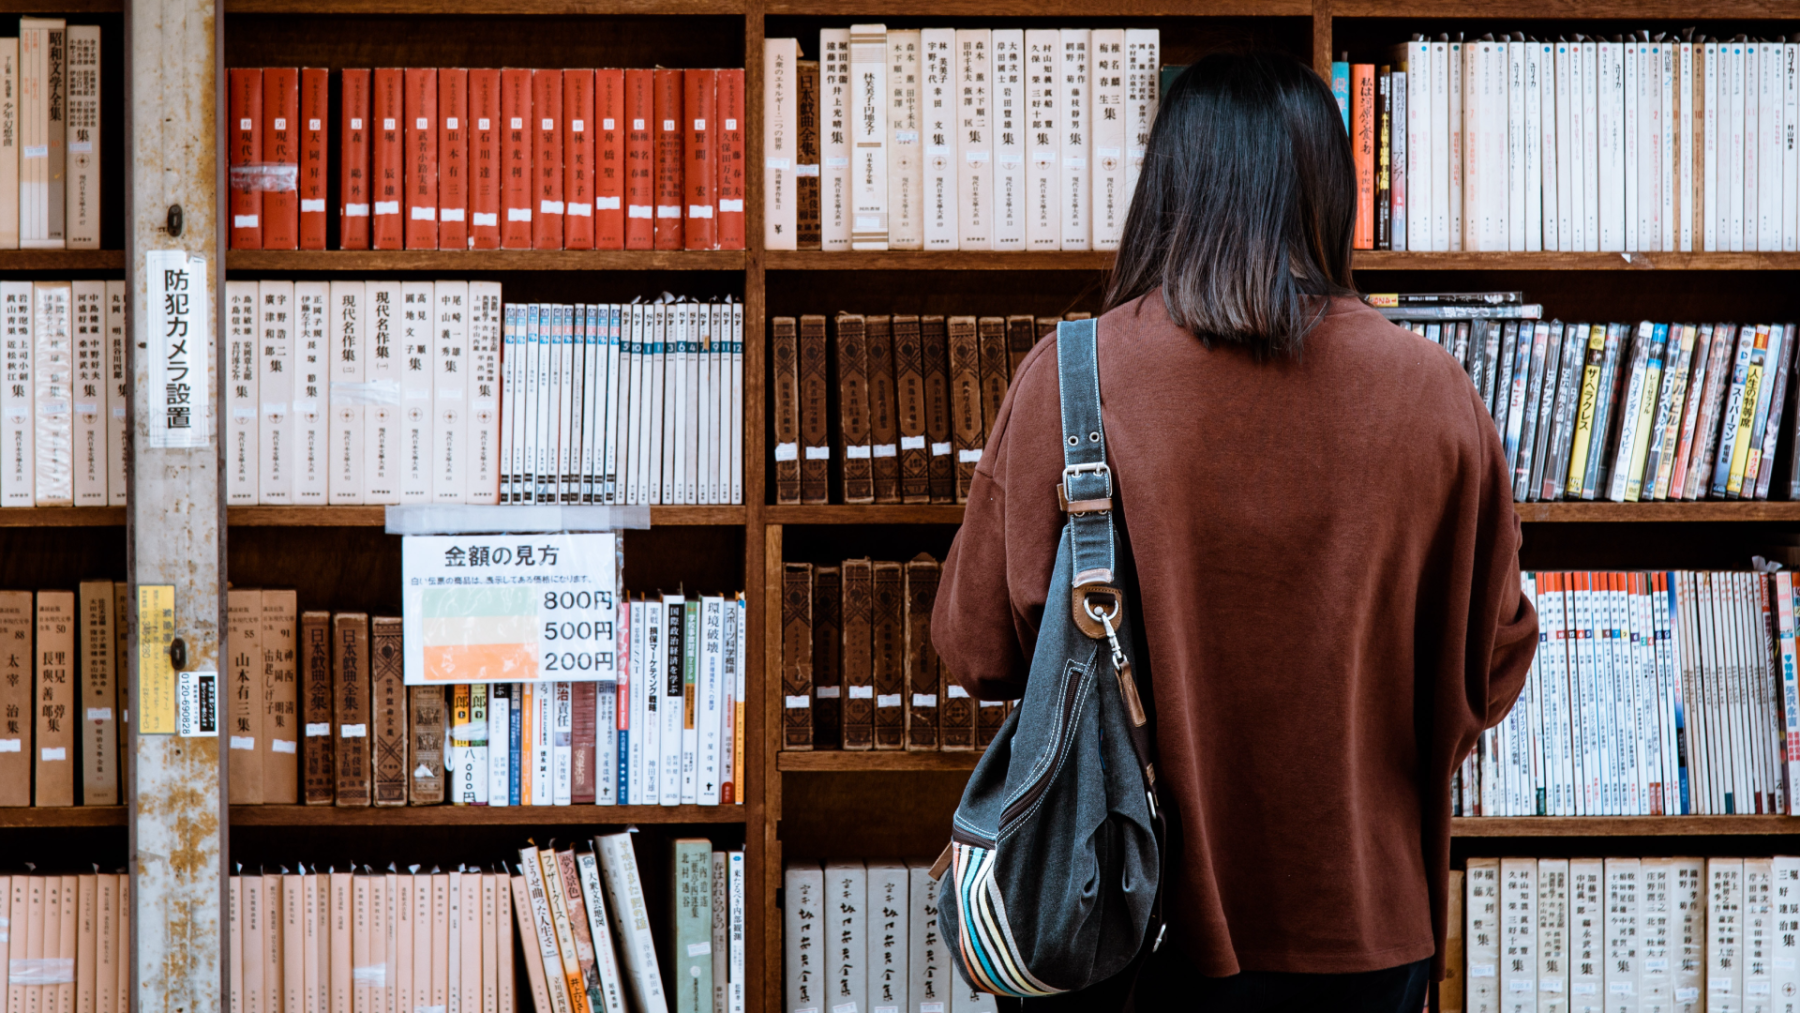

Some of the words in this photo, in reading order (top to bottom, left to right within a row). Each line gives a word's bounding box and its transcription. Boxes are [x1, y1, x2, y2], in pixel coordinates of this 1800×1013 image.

[50, 32, 62, 121] 昭和文学全集
[826, 42, 836, 84] 遠藤周作
[893, 43, 902, 84] 木下順二
[928, 42, 937, 84] 宇野千代
[939, 42, 947, 84] 林芙美子
[997, 42, 1006, 84] 岸田國士
[1042, 44, 1052, 84] 村山知義
[1110, 43, 1121, 104] 椎名麟三
[774, 54, 783, 151] 大衆のエネルギー・二つの世界
[832, 86, 842, 129] 井上光晴
[863, 72, 875, 135] 林芙美子・円地文子
[933, 87, 942, 130] 幸田文
[975, 87, 986, 128] 木下順二
[1031, 90, 1042, 129] 三好十郎
[1103, 107, 1116, 121] 集
[3, 102, 13, 147] 少年幻想曲
[77, 129, 89, 142] 集
[831, 131, 844, 144] 集
[932, 133, 945, 146] 集
[968, 130, 982, 144] 集
[1002, 132, 1015, 145] 集
[1036, 132, 1049, 146] 集
[1069, 132, 1082, 145] 集
[448, 131, 459, 194] 山本有三
[480, 131, 490, 195] 石川達三
[511, 131, 522, 192] 横光利一
[543, 132, 553, 196] 室生犀星
[574, 132, 584, 196] 林芙美子
[604, 132, 614, 192] 舟橋聖一
[695, 132, 705, 196] 野間宏
[721, 132, 731, 196] 久保田万太郎
[731, 132, 742, 196] 佐藤春夫
[18, 293, 28, 336] 岩野泡鳴
[231, 295, 241, 336] 小島信夫
[243, 295, 252, 336] 島尾敏雄
[276, 294, 287, 357] 宇野浩二
[301, 295, 311, 338] 伊藤左千夫
[313, 296, 323, 338] 正岡子規
[341, 295, 357, 362] 現代名作集
[375, 291, 390, 360] 現代名作集
[416, 293, 427, 355] 高見順
[441, 295, 451, 357] 中山義秀
[451, 295, 462, 357] 尾崎一雄
[7, 340, 17, 381] 近松秋江
[78, 339, 88, 381] 桑原武夫
[90, 339, 100, 381] 中野好夫
[165, 269, 191, 429] 防犯カメラ設置
[231, 341, 241, 381] 吉行淳之介
[243, 341, 252, 381] 安岡章太郎
[270, 360, 283, 373] 集
[307, 341, 317, 383] 長塚節
[409, 357, 422, 372] 集
[444, 360, 457, 373] 集
[632, 343, 642, 352] 10
[668, 344, 674, 352] 3
[678, 343, 685, 352] 6
[689, 344, 696, 352] 4
[712, 343, 719, 351] 9
[733, 344, 742, 352] 12
[12, 384, 25, 398] 集
[83, 384, 97, 398] 集
[236, 385, 249, 398] 集
[305, 385, 318, 398] 集
[1579, 369, 1599, 430] ザ・ヘラクレス
[1667, 372, 1688, 426] キル・ビル
[1740, 369, 1759, 427] 人生の特等席
[1725, 388, 1742, 441] スーパーマン
[444, 545, 560, 567] 金額の見方
[544, 590, 612, 611] 800円
[15, 631, 25, 640] 88
[56, 625, 66, 633] 50
[244, 630, 255, 638] 55
[280, 629, 290, 637] 91
[544, 621, 613, 640] 500円
[707, 602, 719, 653] 環境破壊
[725, 608, 735, 674] スポーツ科学概論
[544, 651, 614, 671] 200円
[648, 627, 658, 711] 損保マーケティング戦略
[669, 607, 679, 693] 国際政治経済を学ぶ
[6, 654, 20, 734] 太宰治集
[181, 673, 190, 735] 0120-690828
[235, 652, 250, 732] 山本有三集
[47, 719, 60, 732] 集
[544, 855, 566, 920] ファザー・グース
[558, 855, 581, 899] 夢の景色
[619, 841, 648, 930] それはまた別の話
[681, 852, 689, 907] 北村透谷
[713, 862, 724, 929] 春はわれらのもの
[1657, 872, 1666, 912] 阿川弘之
[527, 857, 553, 948] どうせ曲った人生さ
[1473, 870, 1482, 930] 伊藤整
[1484, 870, 1494, 927] 横光利一
[1779, 869, 1788, 931] 三好達治
[1789, 869, 1799, 931] 堀辰雄
[1477, 933, 1489, 946] 集
[1582, 919, 1591, 959] 福永武彦
[1646, 917, 1656, 957] 北杜夫
[1782, 933, 1796, 947] 集
[1580, 962, 1594, 975] 集
